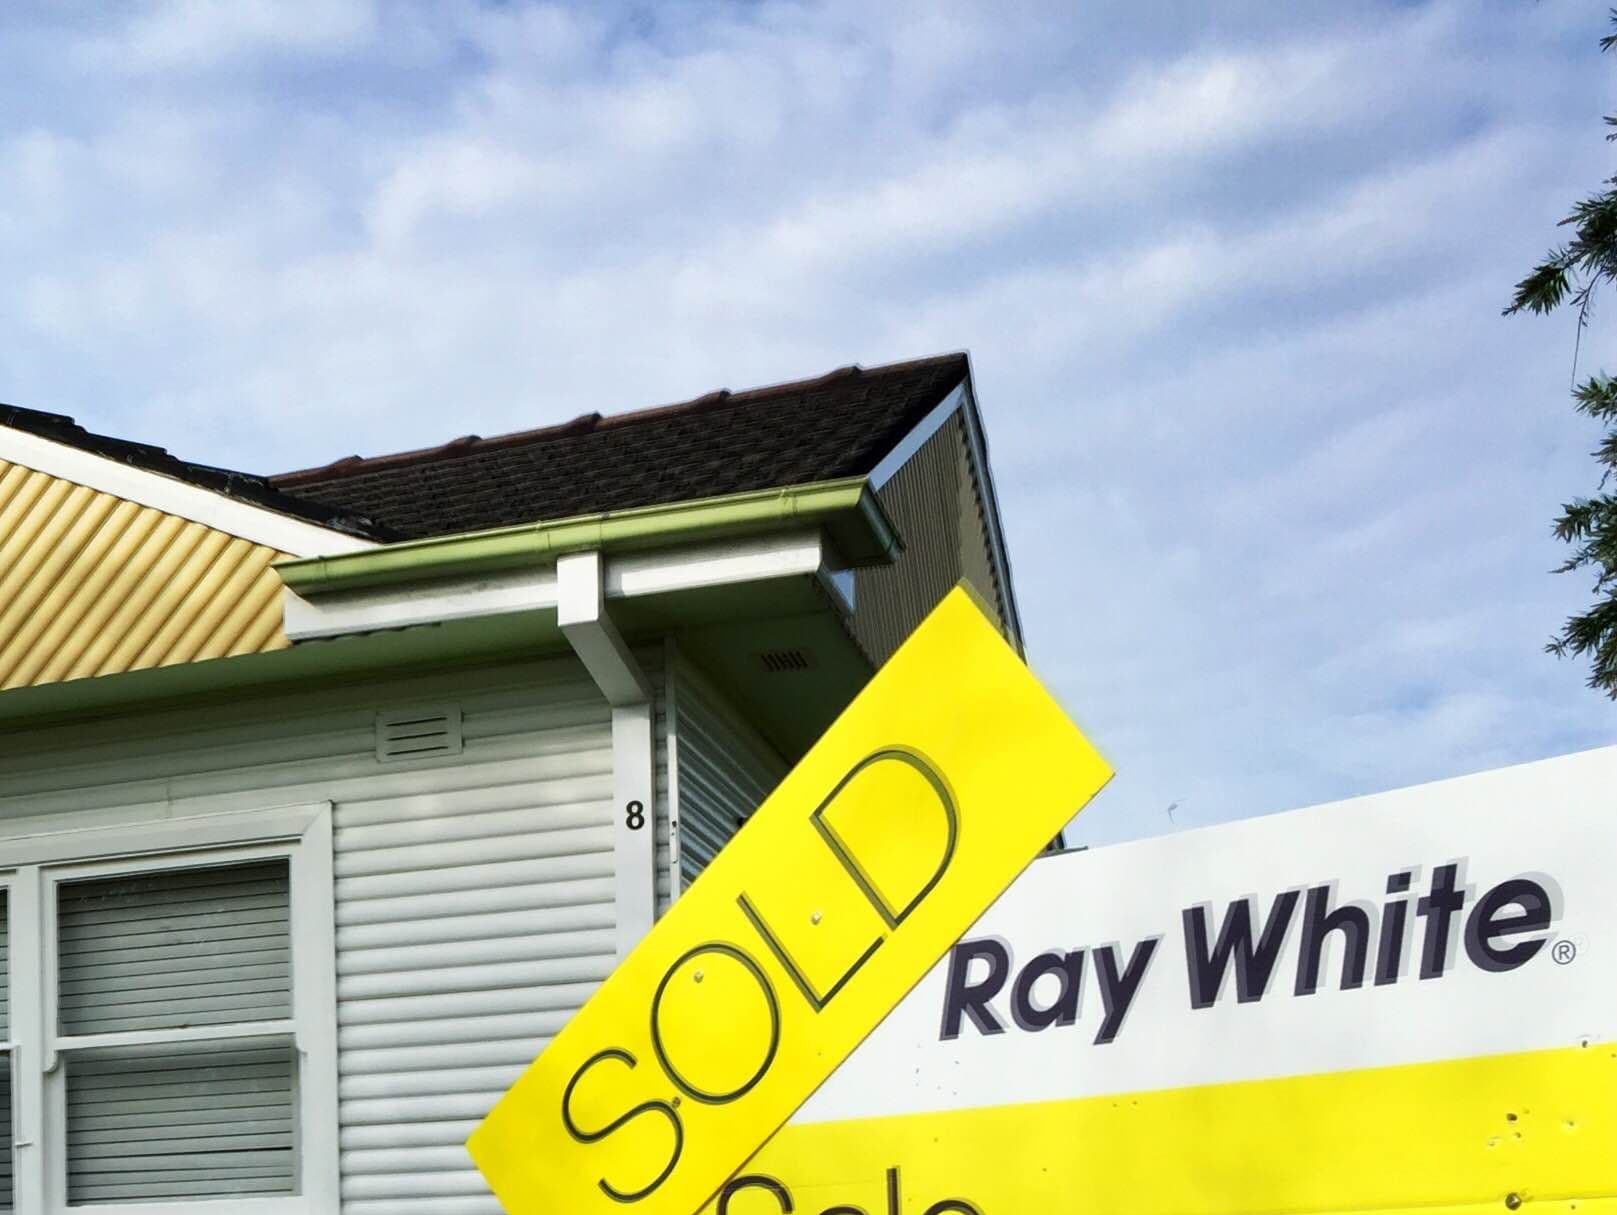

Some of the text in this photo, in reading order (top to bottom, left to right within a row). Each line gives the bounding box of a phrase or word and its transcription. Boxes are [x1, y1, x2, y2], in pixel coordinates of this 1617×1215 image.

[626, 800, 645, 831] 8
[562, 745, 961, 1203] SOLD
[939, 934, 1160, 1045] Ray
